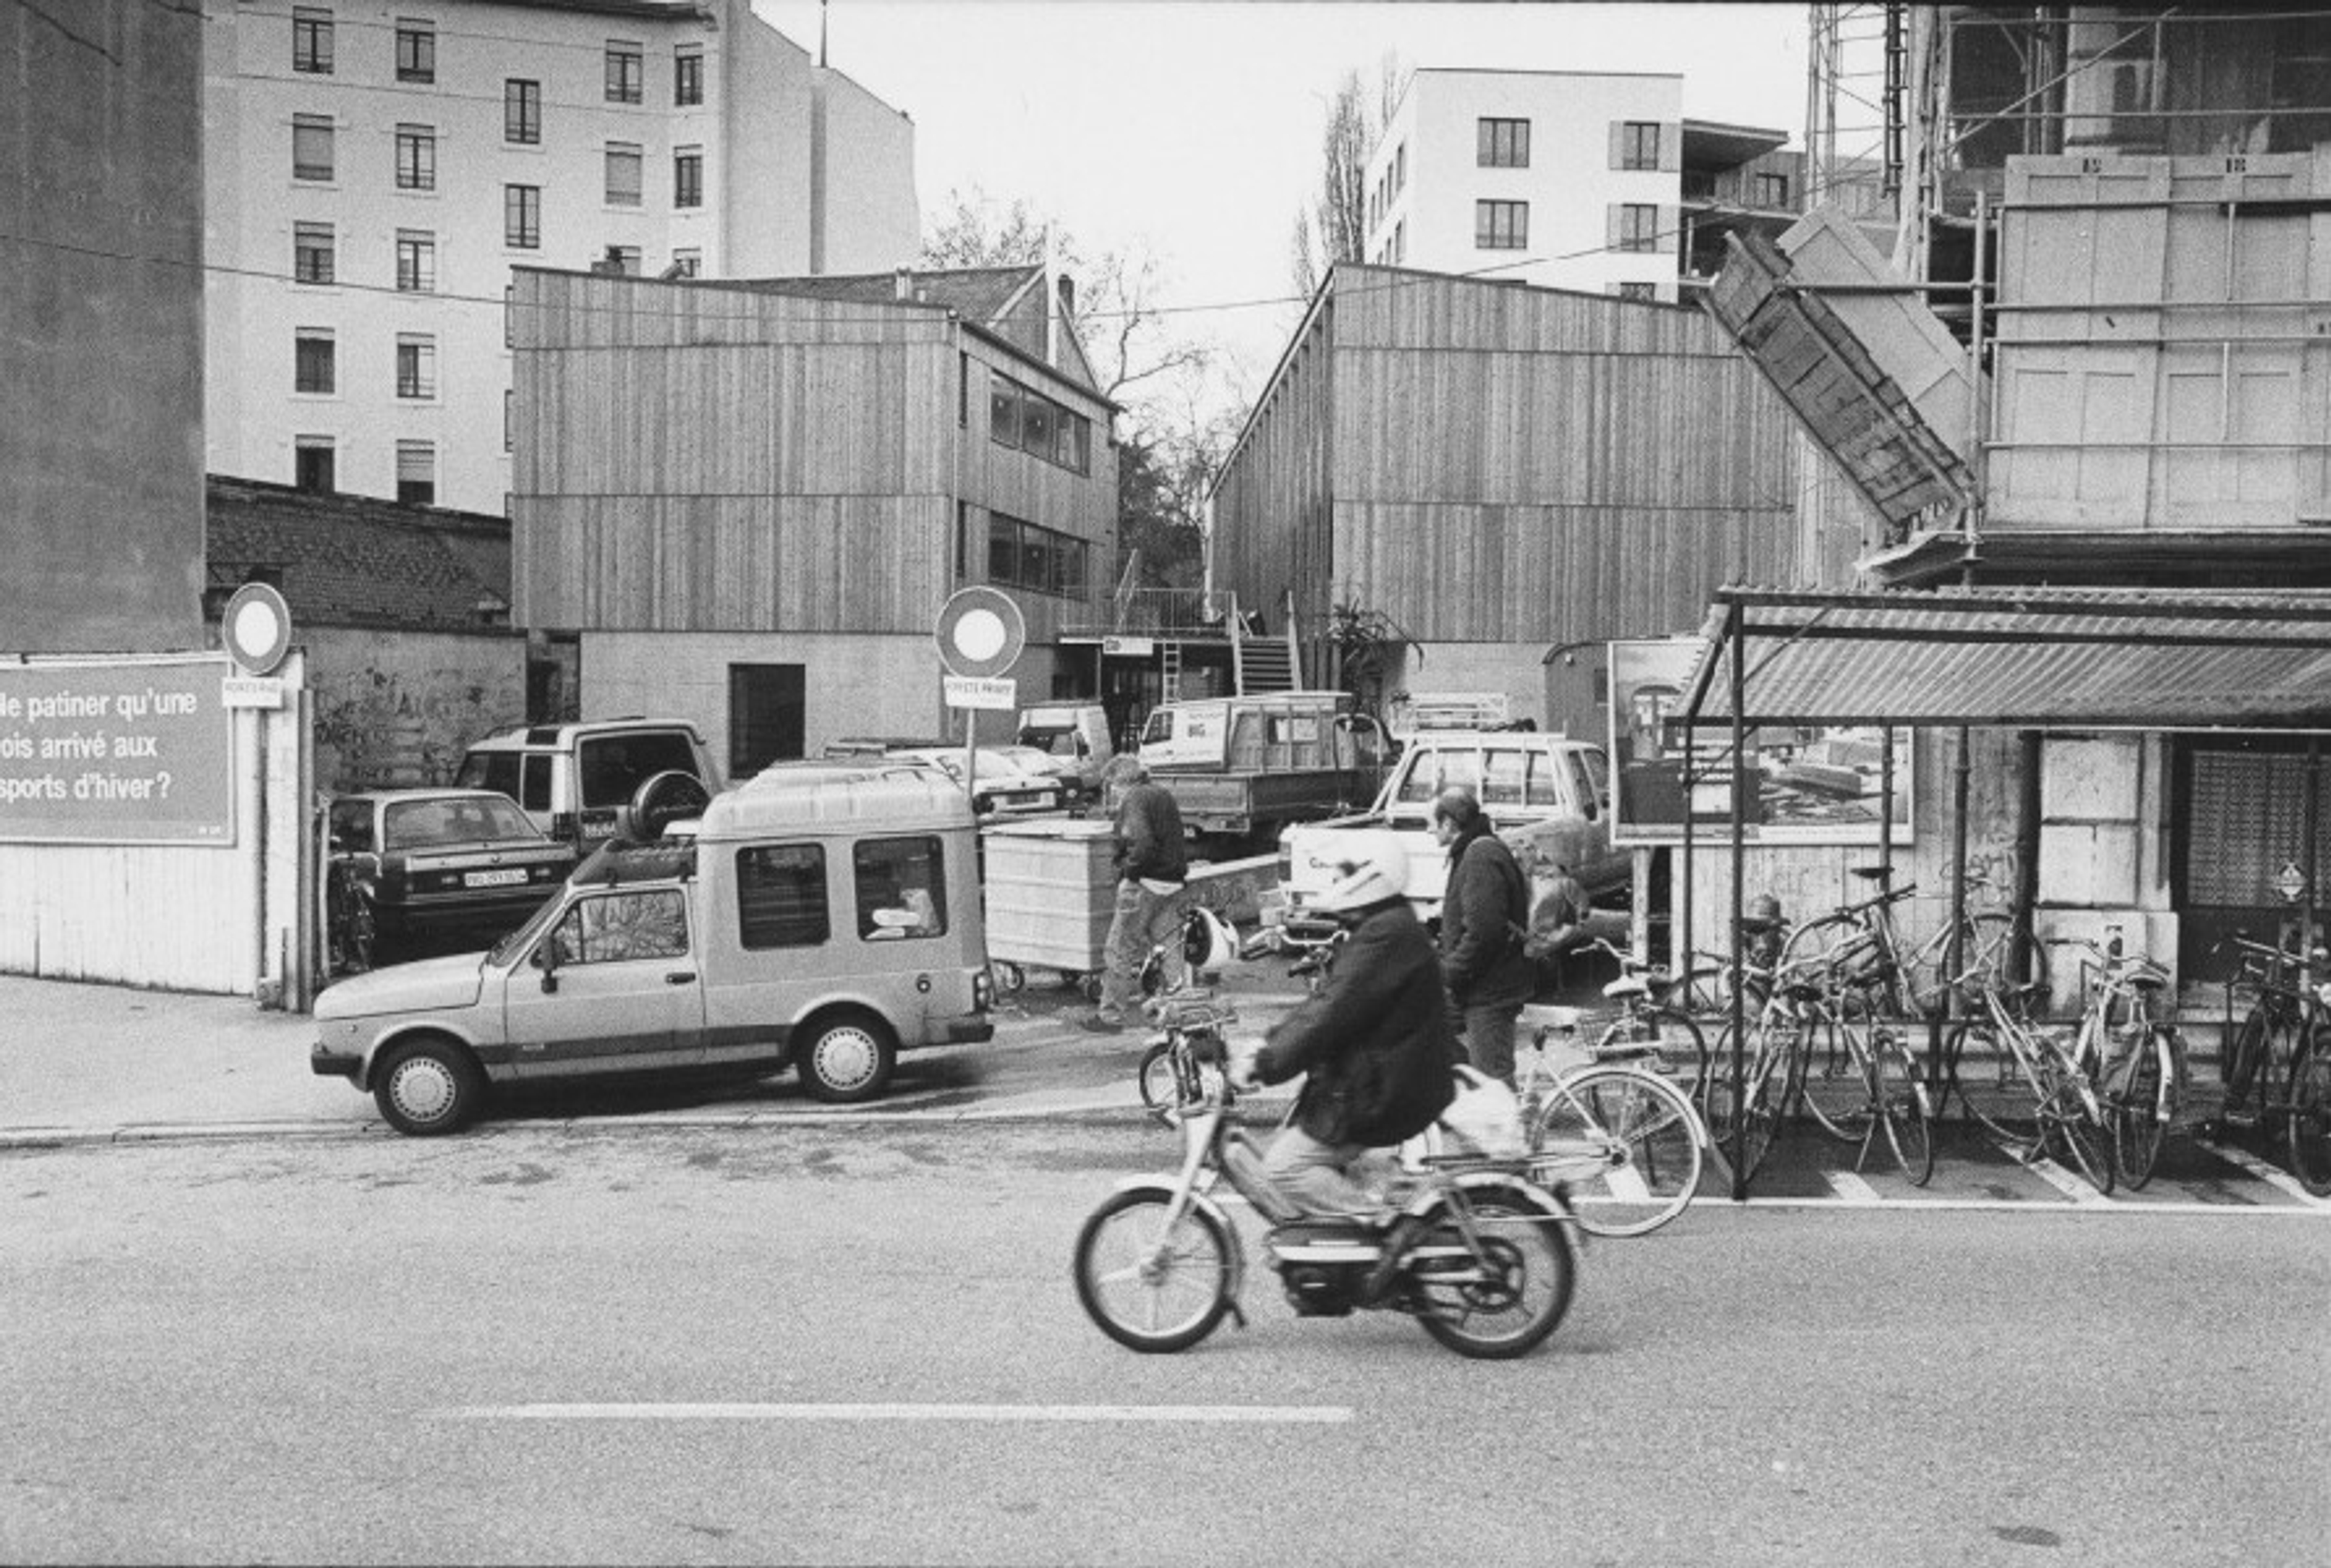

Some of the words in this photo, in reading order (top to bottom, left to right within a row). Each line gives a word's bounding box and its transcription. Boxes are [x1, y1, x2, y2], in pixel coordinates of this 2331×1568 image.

[28, 690, 110, 724] patiner
[116, 687, 198, 722] qu'une
[40, 730, 106, 759] arrivé
[114, 736, 158, 757] aux
[0, 773, 67, 804] sports
